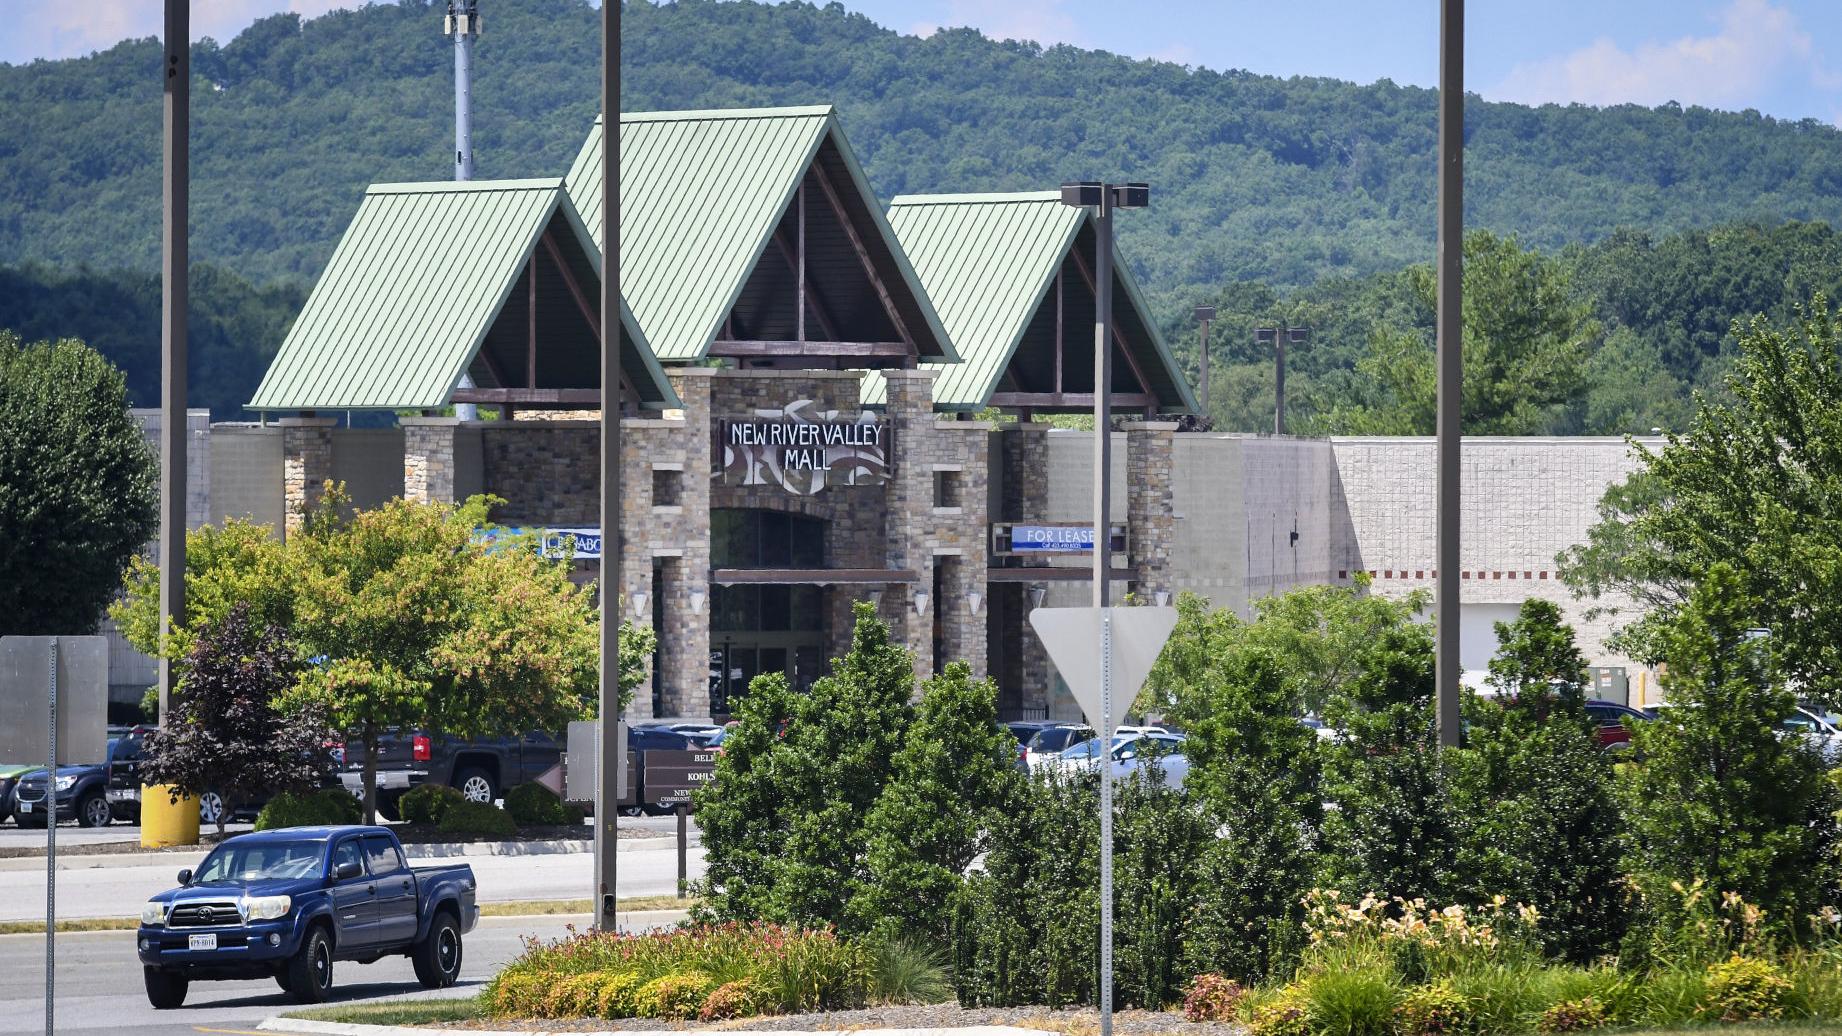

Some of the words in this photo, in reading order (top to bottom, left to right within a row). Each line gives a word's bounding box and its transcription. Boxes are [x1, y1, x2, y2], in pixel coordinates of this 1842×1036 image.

[731, 423, 767, 445] NEW
[771, 423, 820, 445] RIVER
[822, 424, 883, 446] VALLEY
[785, 449, 832, 471] MALL
[1027, 530, 1054, 543] FOR
[1058, 530, 1095, 543] LEASE
